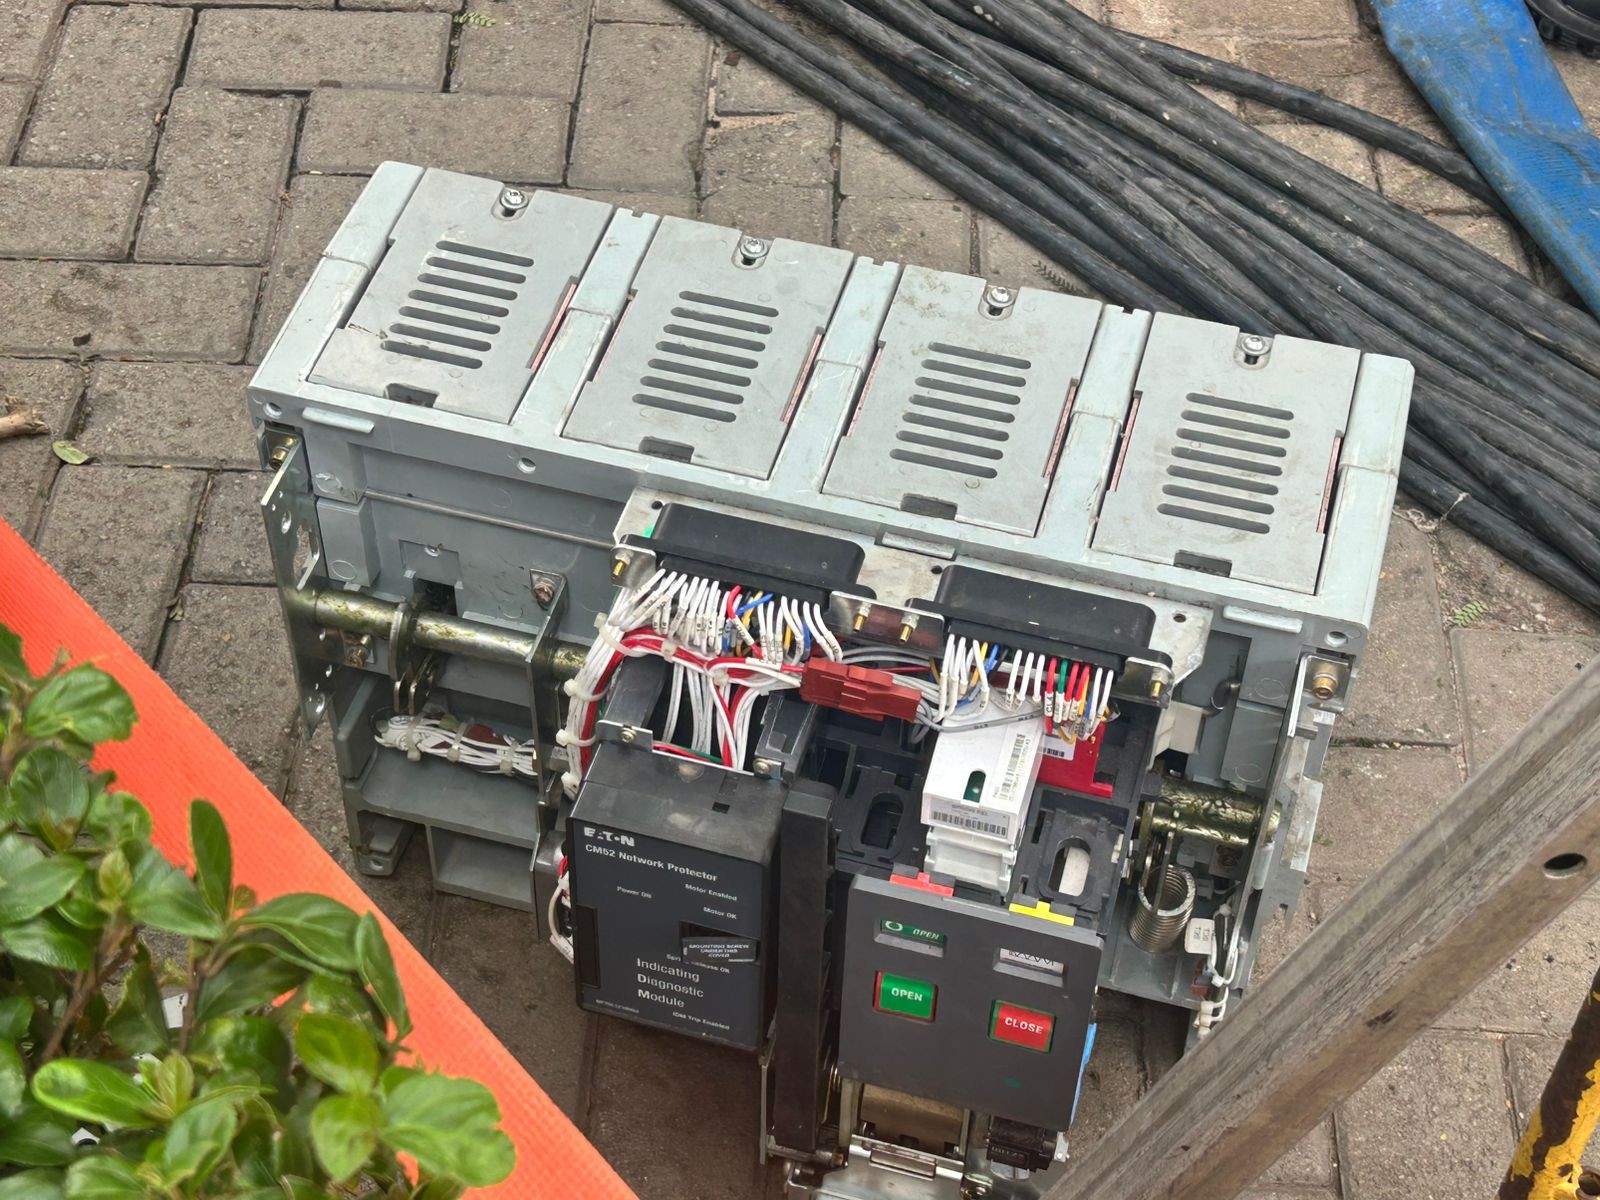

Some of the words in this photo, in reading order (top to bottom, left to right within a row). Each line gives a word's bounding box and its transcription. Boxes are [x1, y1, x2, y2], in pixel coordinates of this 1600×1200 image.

[585, 843, 616, 858] CM52
[618, 850, 665, 870] Network
[667, 862, 719, 882] Protector
[685, 883, 707, 895] Motor
[708, 889, 738, 902] Enabled
[703, 906, 725, 917] Motor
[912, 927, 940, 941] OPEN
[637, 957, 700, 983] Indicating
[637, 973, 704, 998] Diagnostic
[890, 986, 923, 1002] OPEN
[637, 988, 685, 1008] Module
[1004, 1015, 1043, 1035] CLOSE
